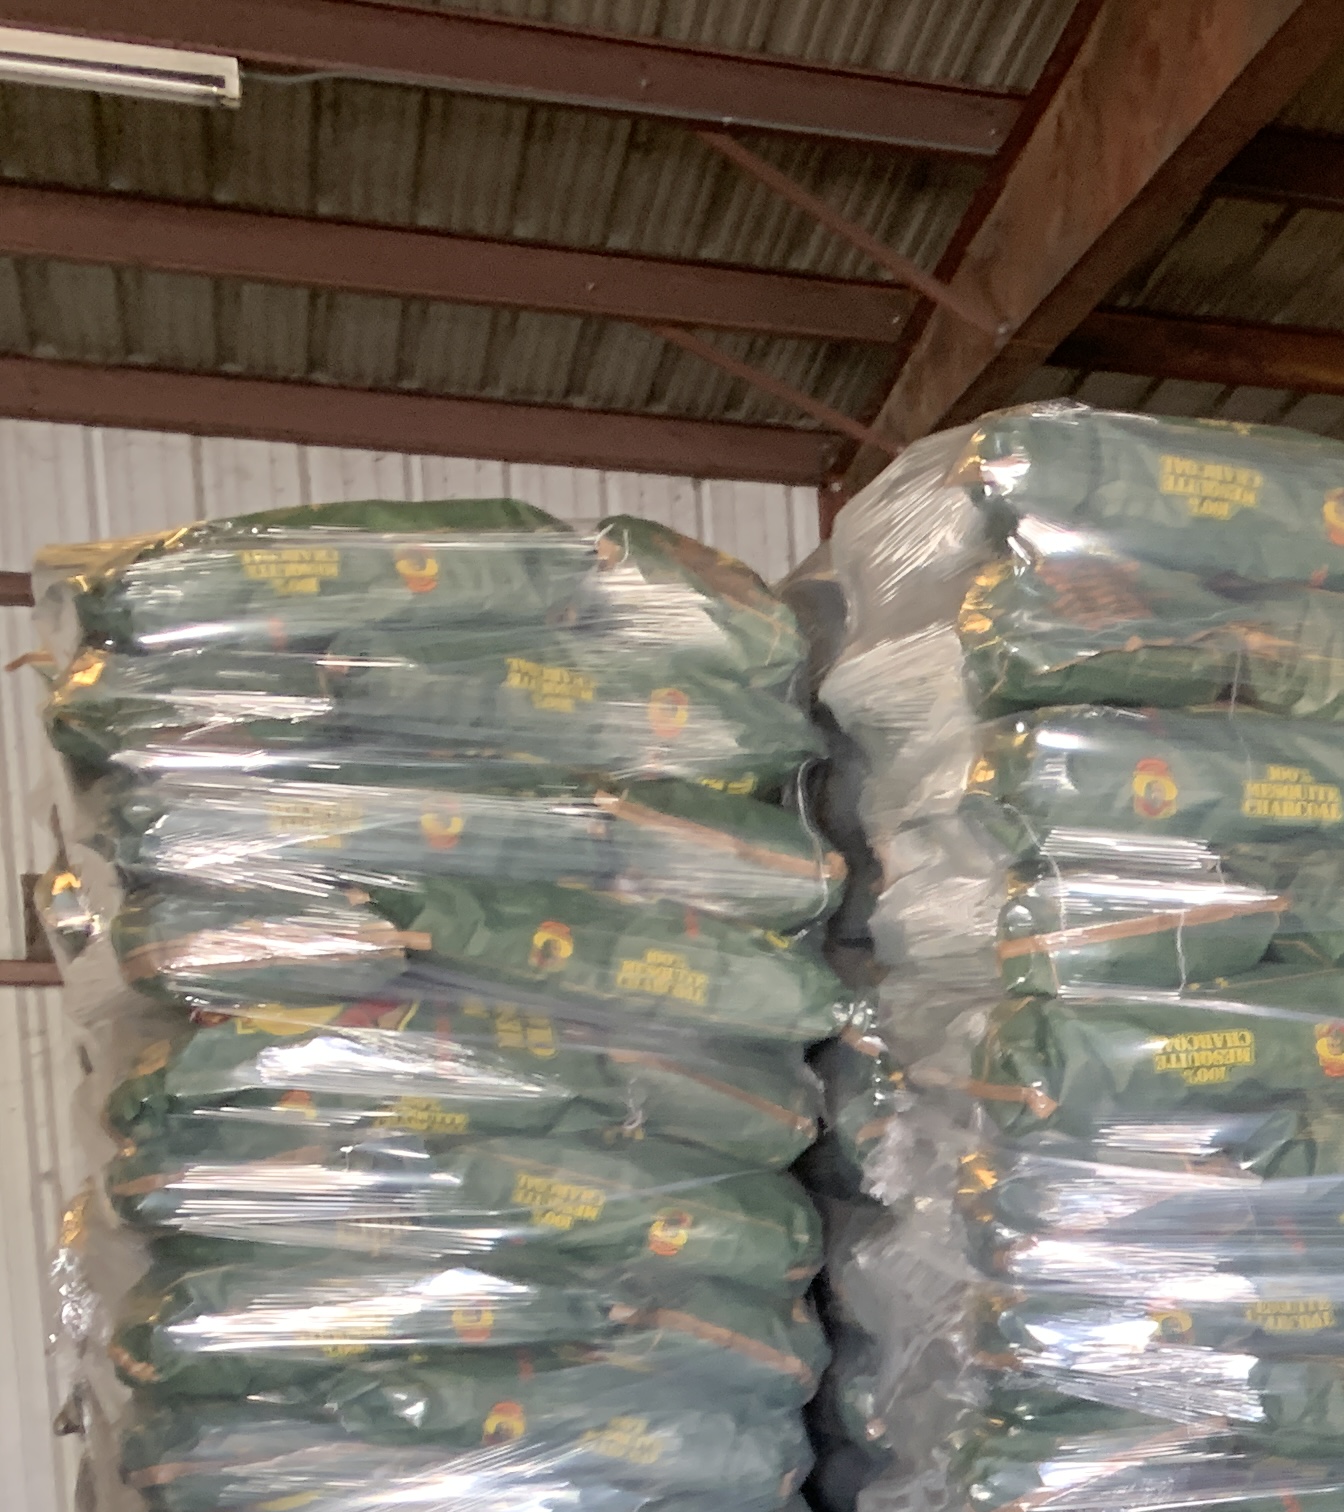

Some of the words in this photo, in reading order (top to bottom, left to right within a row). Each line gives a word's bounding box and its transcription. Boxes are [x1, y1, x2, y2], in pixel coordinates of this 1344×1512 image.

[1243, 799, 1342, 819] CHARCOAL
[1155, 1048, 1251, 1070] MESQUITE
[1183, 1066, 1228, 1084] 100%
